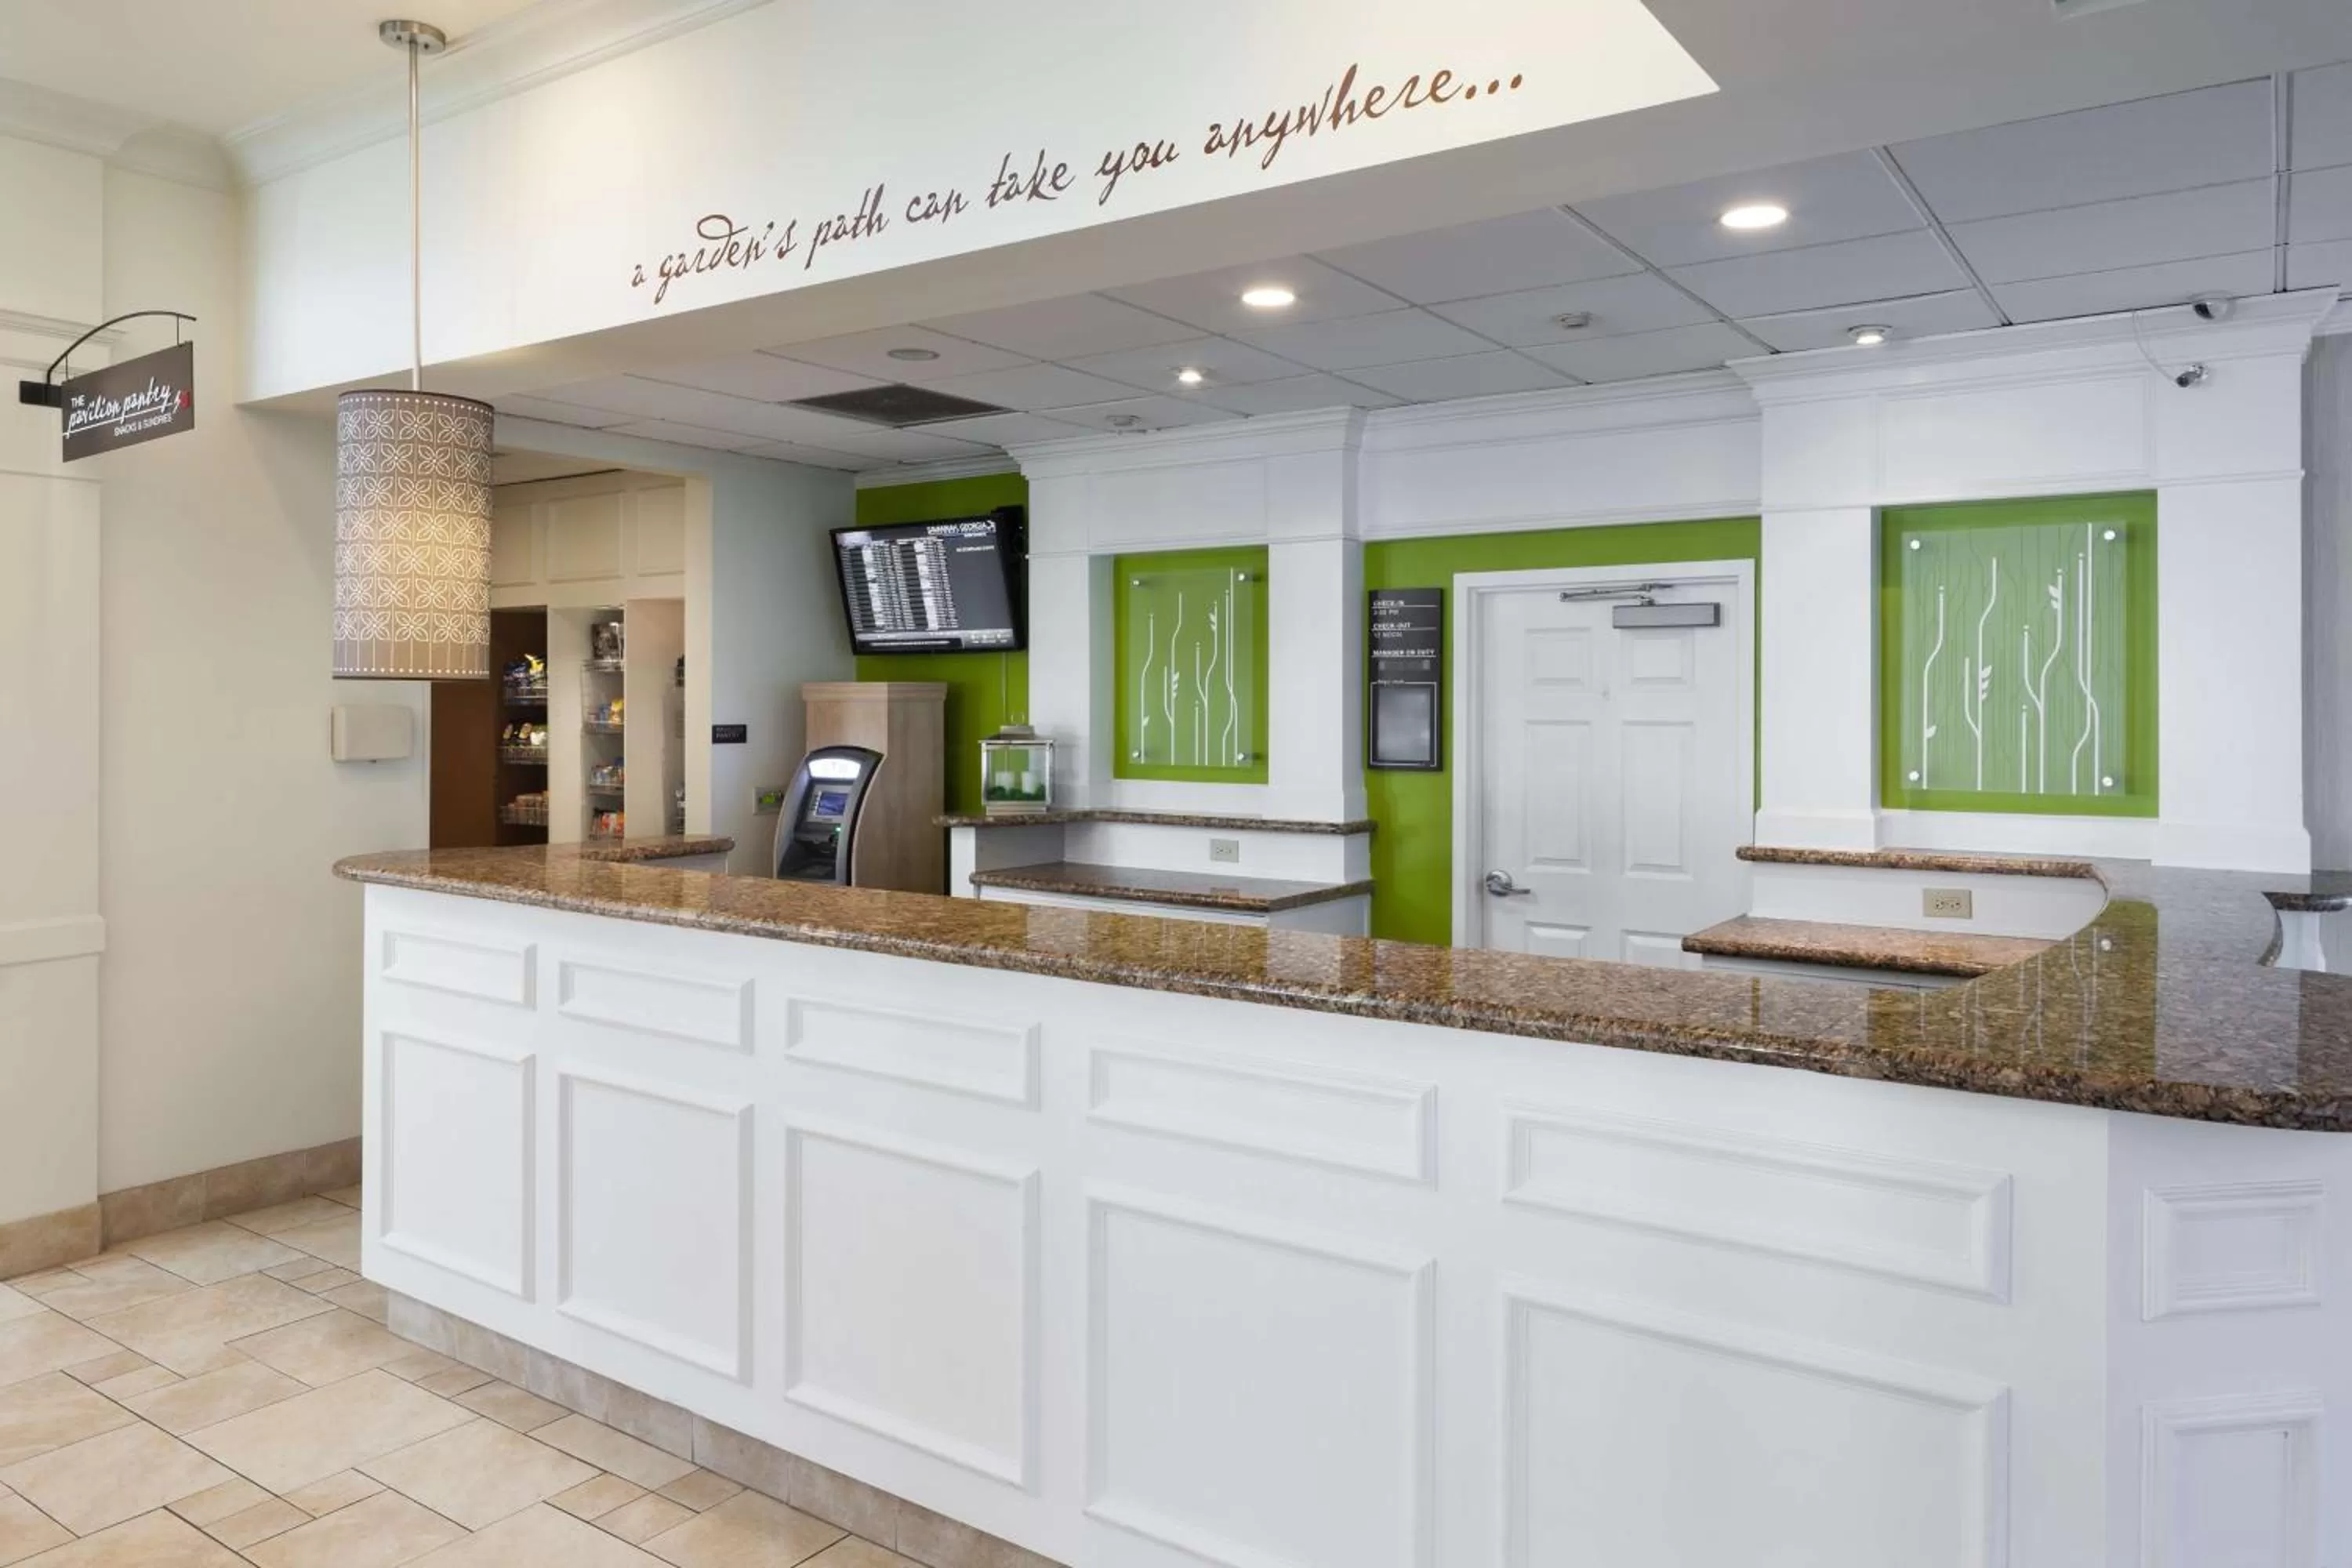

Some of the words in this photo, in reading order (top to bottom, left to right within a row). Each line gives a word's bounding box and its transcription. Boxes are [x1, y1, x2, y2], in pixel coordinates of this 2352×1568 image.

[631, 263, 647, 288] a
[653, 214, 798, 305] garden's
[804, 183, 890, 270] path
[906, 188, 970, 225] can
[985, 148, 1076, 209] take
[1094, 139, 1180, 207] you
[71, 394, 85, 408] THE
[120, 376, 172, 424] pantry
